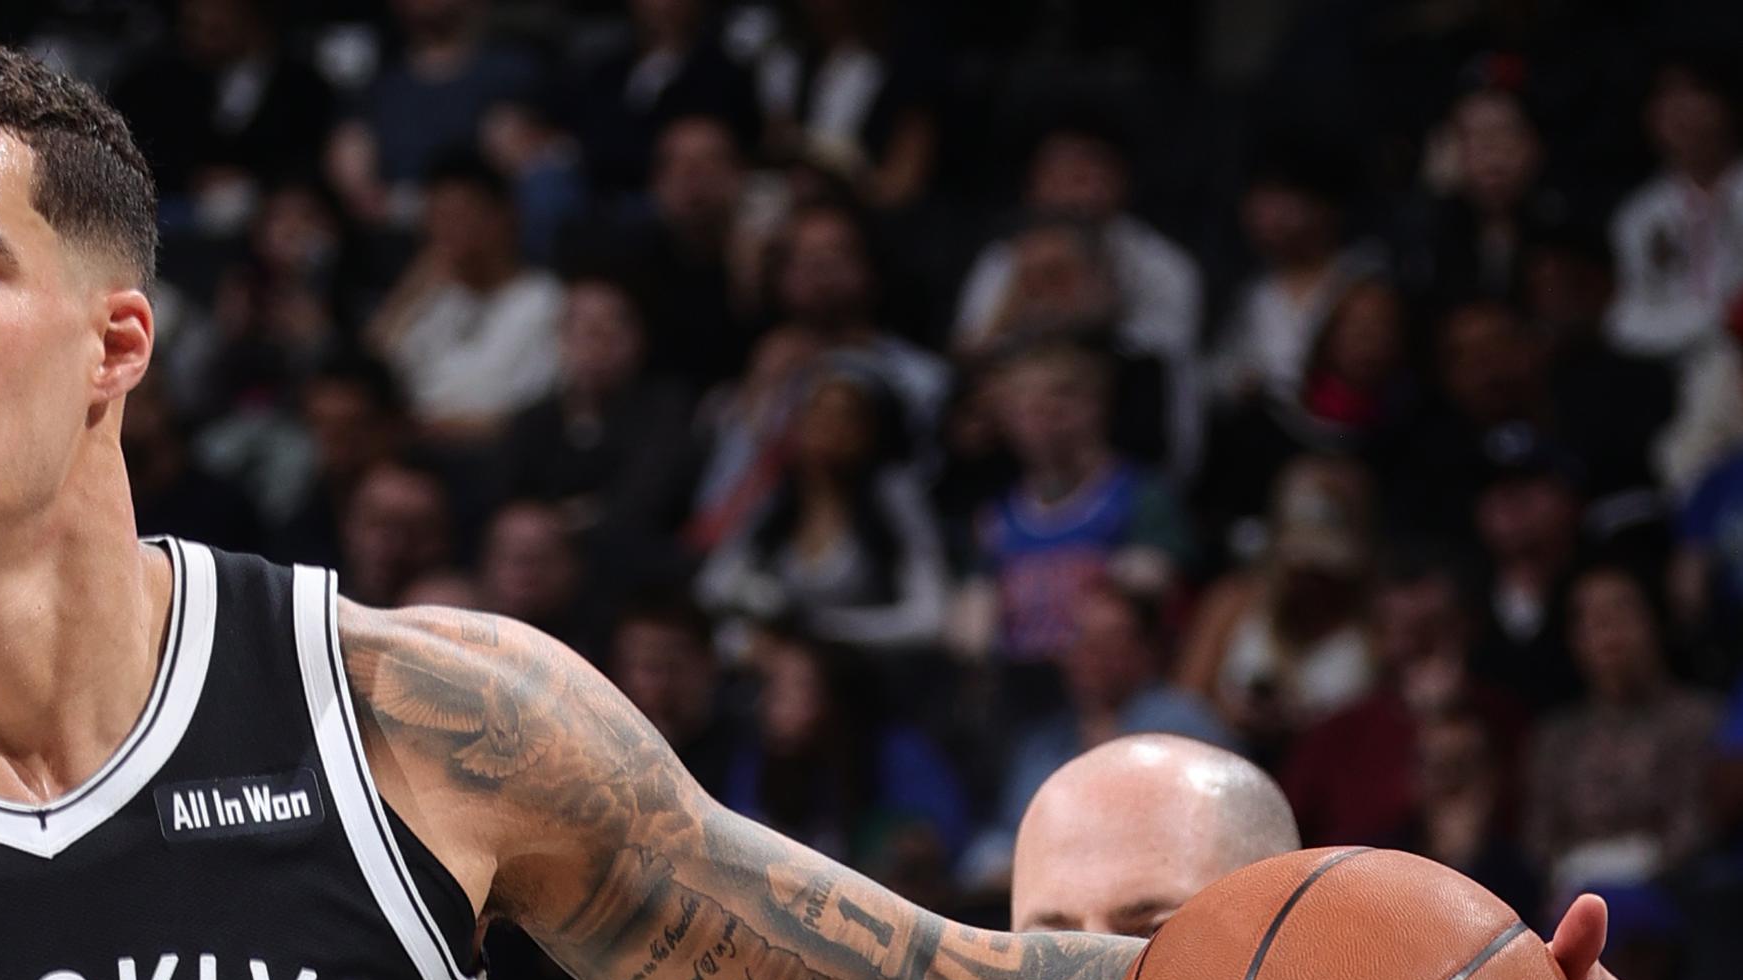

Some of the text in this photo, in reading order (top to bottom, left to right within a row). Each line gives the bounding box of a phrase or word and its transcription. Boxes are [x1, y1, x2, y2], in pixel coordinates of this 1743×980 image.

[172, 783, 312, 831] All In Won
